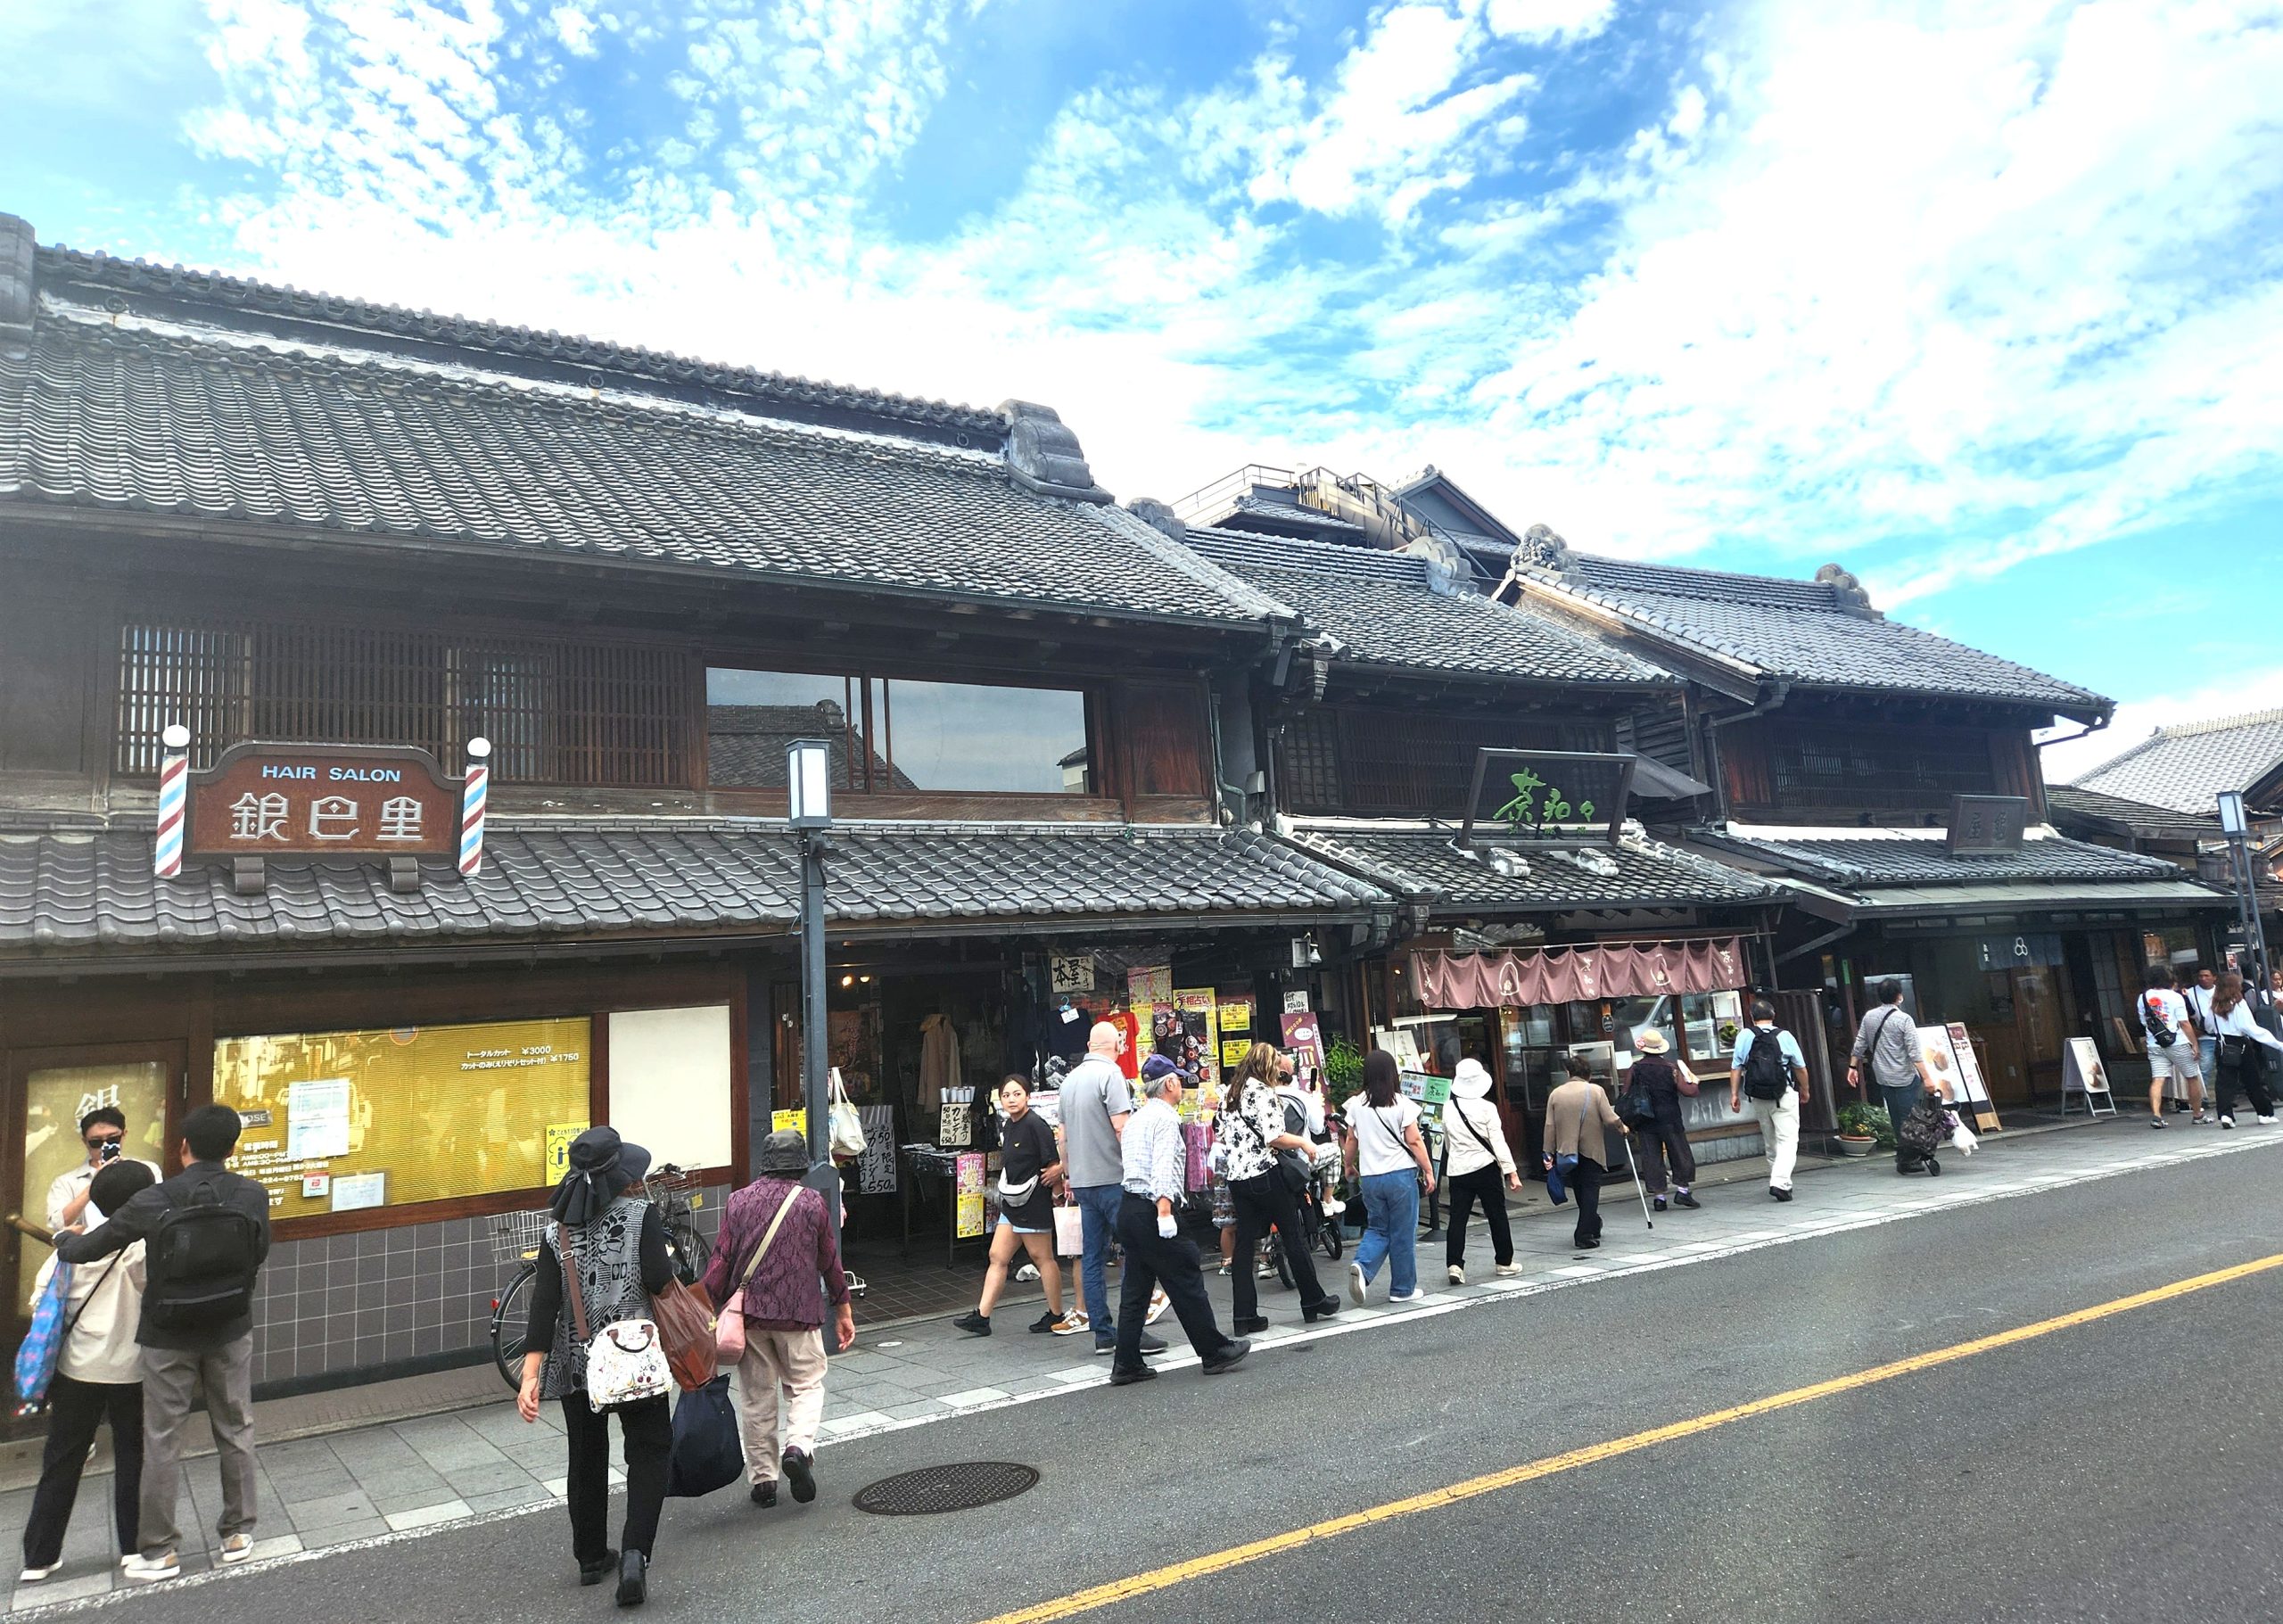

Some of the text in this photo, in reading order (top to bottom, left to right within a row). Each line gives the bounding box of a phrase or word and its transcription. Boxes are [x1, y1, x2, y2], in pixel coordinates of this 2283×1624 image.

[262, 765, 400, 782] HAIR SALON
[522, 1045, 551, 1056] ¥3000
[951, 1107, 962, 1143] カレンダー
